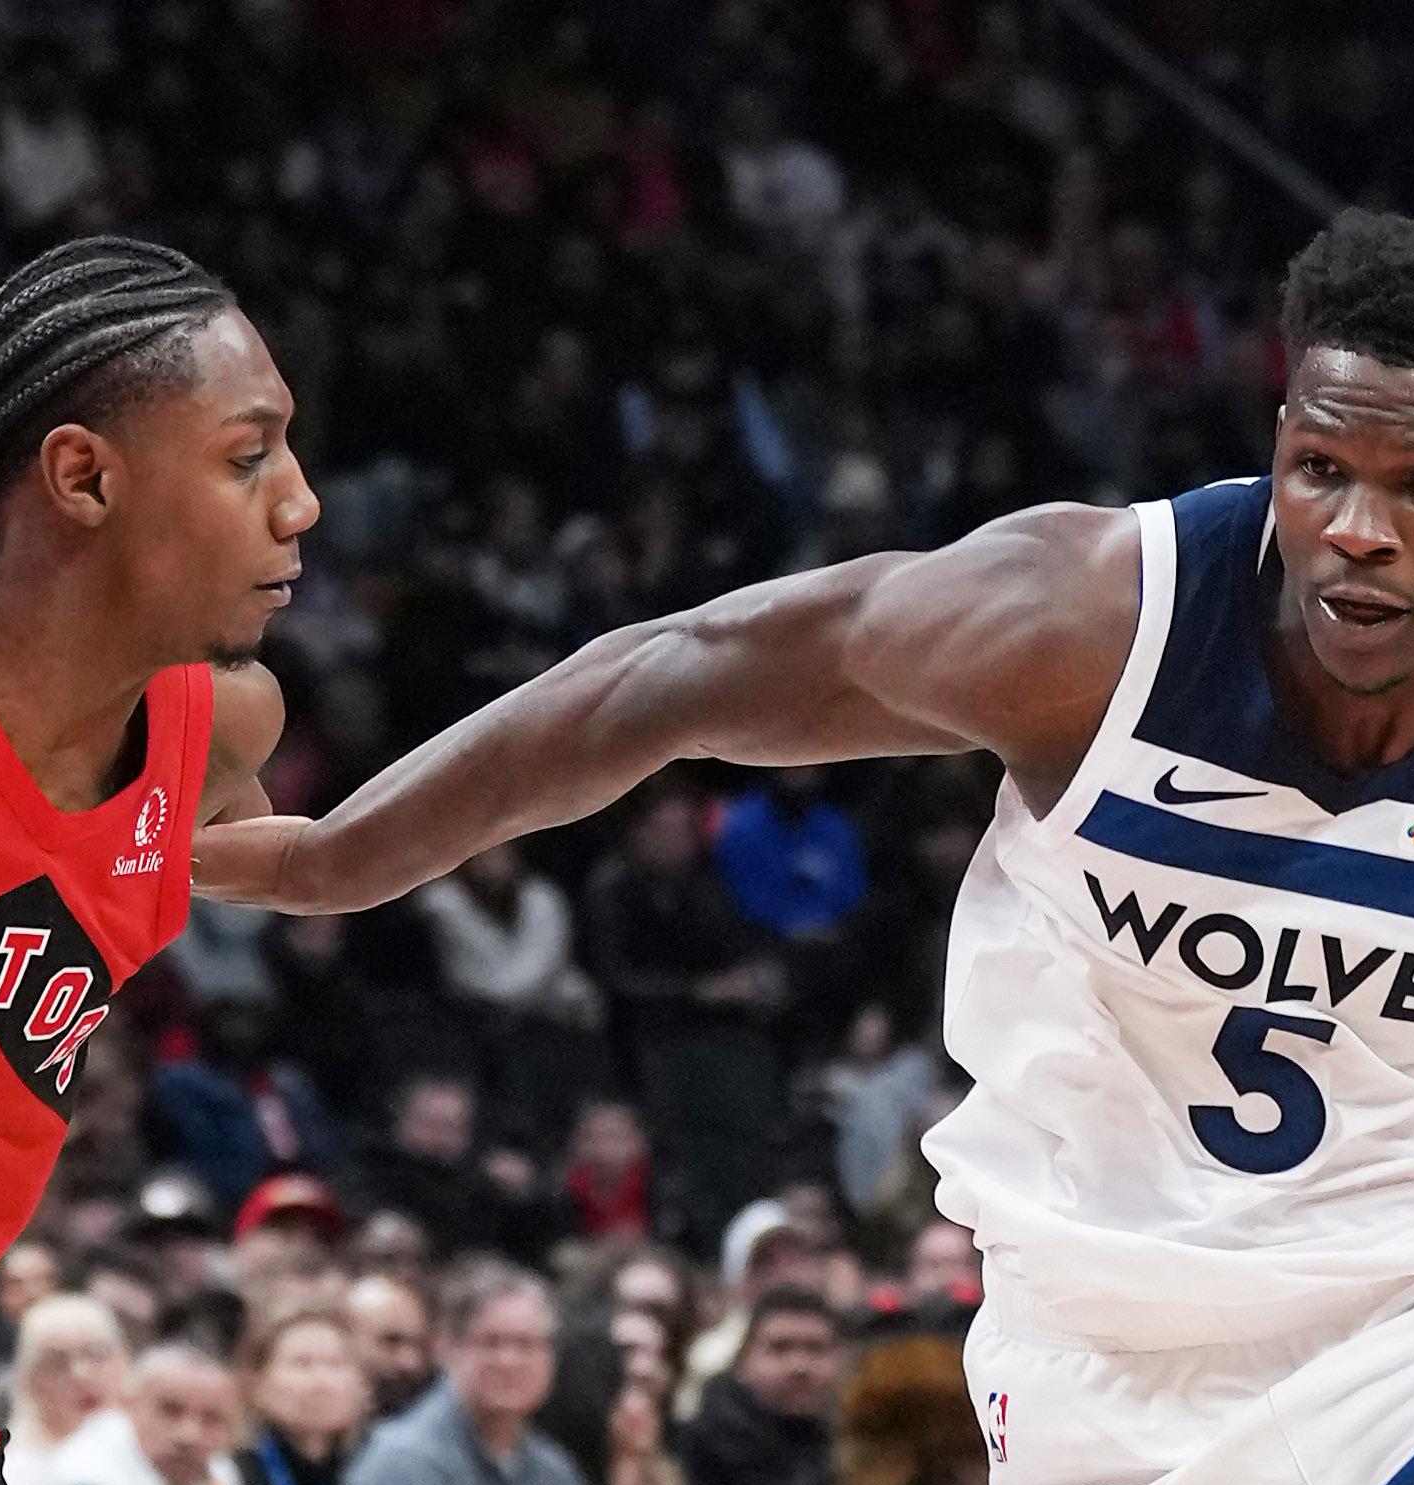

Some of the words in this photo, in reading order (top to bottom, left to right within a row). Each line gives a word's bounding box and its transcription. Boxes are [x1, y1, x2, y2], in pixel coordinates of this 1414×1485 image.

[111, 856, 137, 876] Sun
[137, 850, 164, 873] Life
[1188, 1005, 1337, 1174] 5
